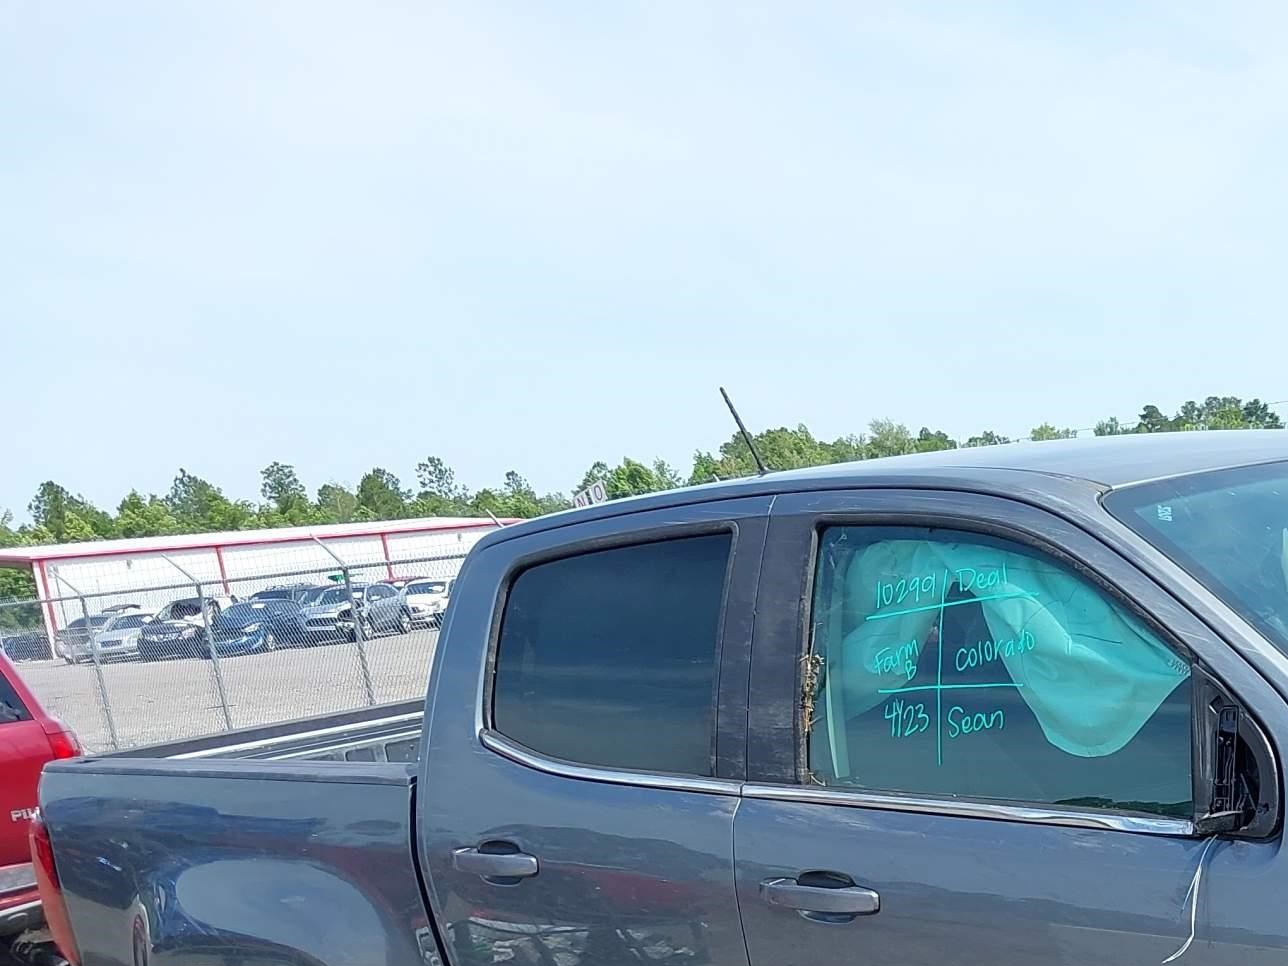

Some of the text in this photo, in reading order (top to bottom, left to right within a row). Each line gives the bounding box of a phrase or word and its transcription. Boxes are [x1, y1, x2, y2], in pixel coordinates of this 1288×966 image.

[876, 572, 936, 609] 10299
[955, 563, 1008, 592] Deal
[874, 639, 919, 676] Farm
[947, 706, 1004, 738] Sean
[10, 807, 39, 822] PIL
